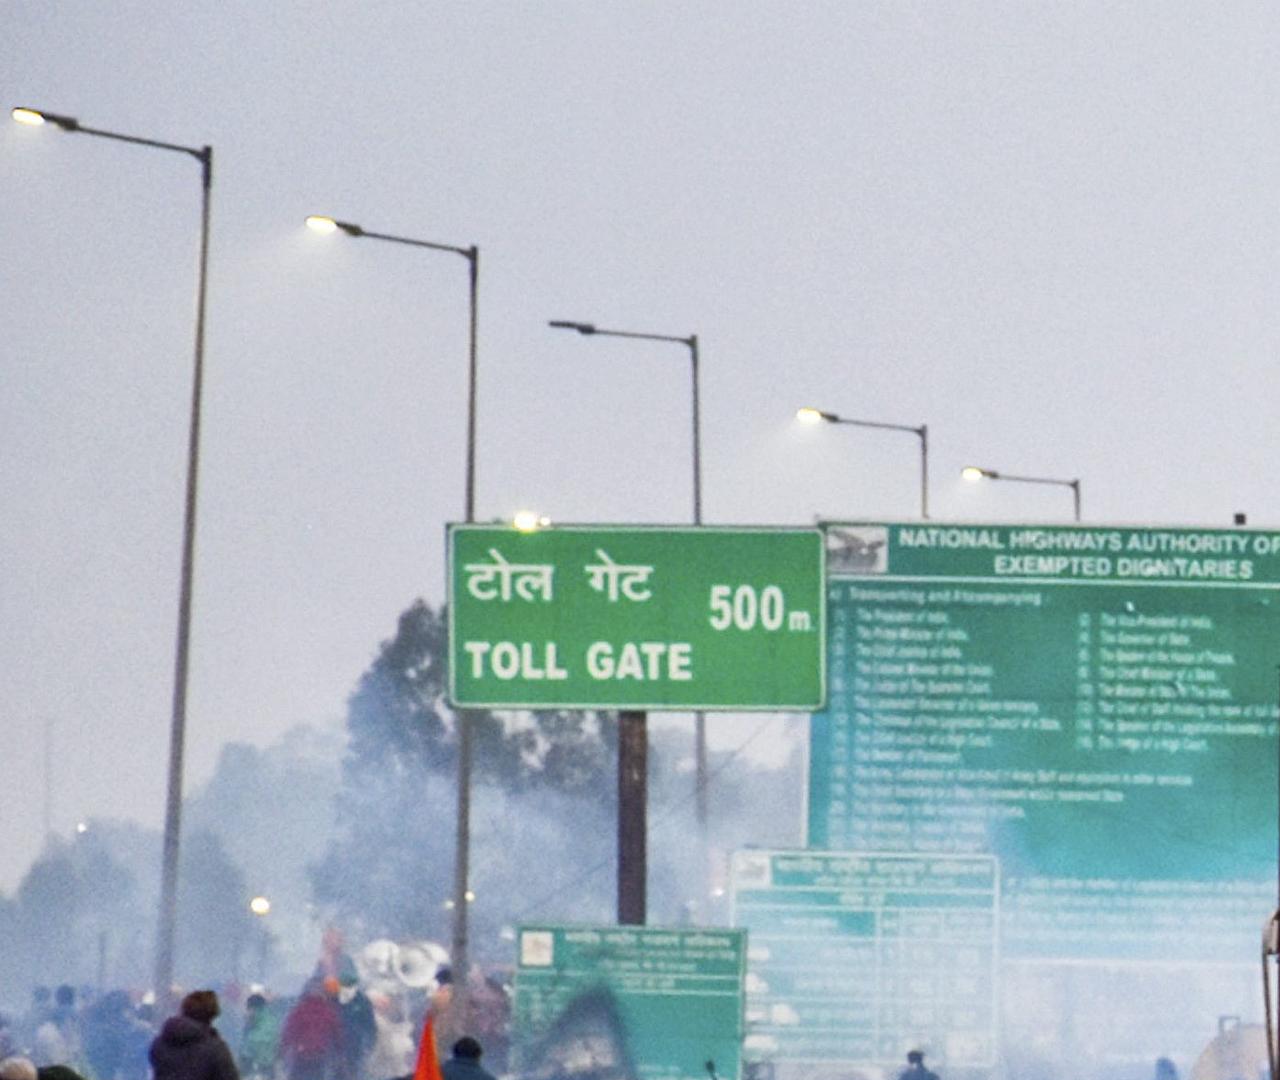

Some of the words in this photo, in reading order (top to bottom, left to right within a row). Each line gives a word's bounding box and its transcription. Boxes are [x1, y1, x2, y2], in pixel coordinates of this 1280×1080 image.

[899, 528, 1004, 549] NATIONAL
[1008, 530, 1122, 551] HIGHWAYS
[1127, 533, 1250, 553] AUTHORITY
[464, 548, 554, 602] टोल
[584, 549, 654, 602] गेट
[994, 555, 1111, 576] EXEMPTED
[1117, 557, 1254, 579] DIGNITARIES
[464, 641, 568, 680] TOLL
[586, 642, 693, 681] GATE
